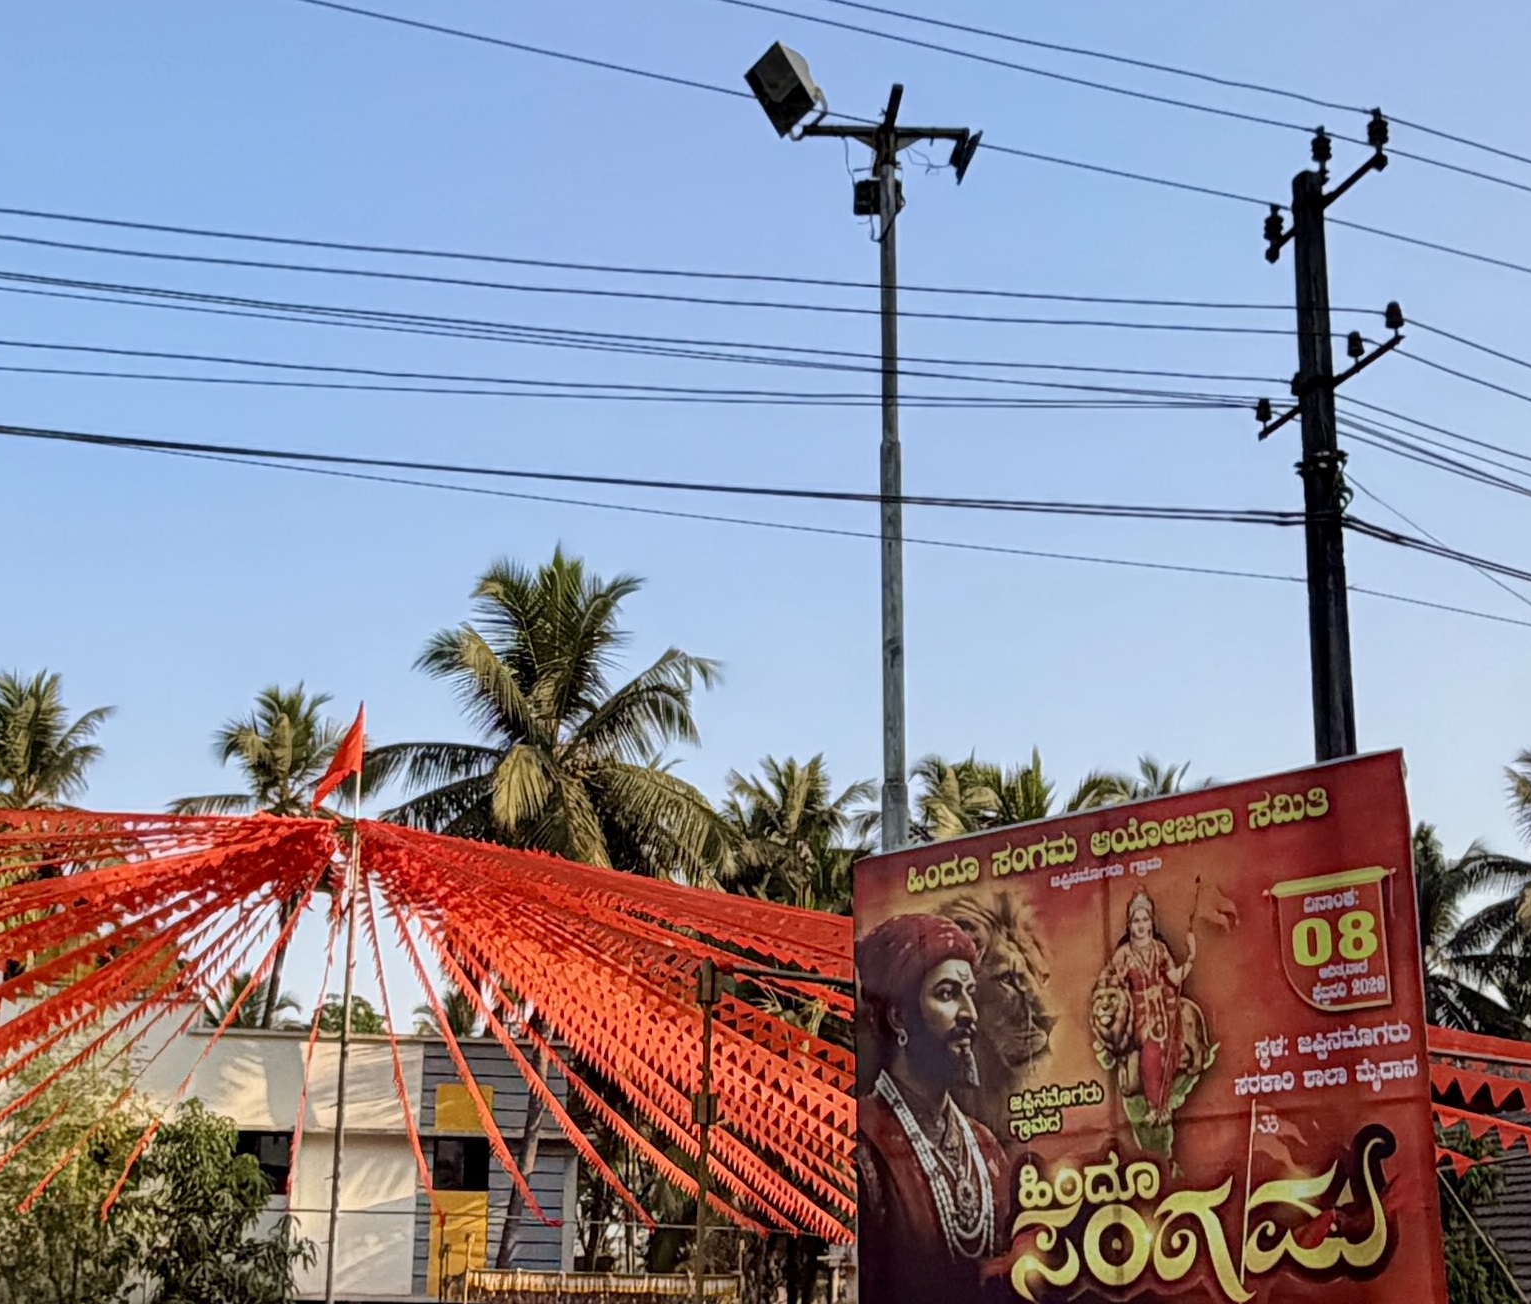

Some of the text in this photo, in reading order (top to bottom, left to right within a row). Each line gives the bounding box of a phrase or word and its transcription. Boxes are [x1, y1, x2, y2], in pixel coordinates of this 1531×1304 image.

[907, 787, 1330, 892] ಹಿಂದೂ ಸಂಗಮ ಆಯೋಜನಾ ಸಮಿತಿ
[1292, 910, 1378, 967] 08
[1255, 1034, 1289, 1070] ಸ್ಥಳ:
[1018, 1150, 1160, 1208] ಹಿಂದೂ
